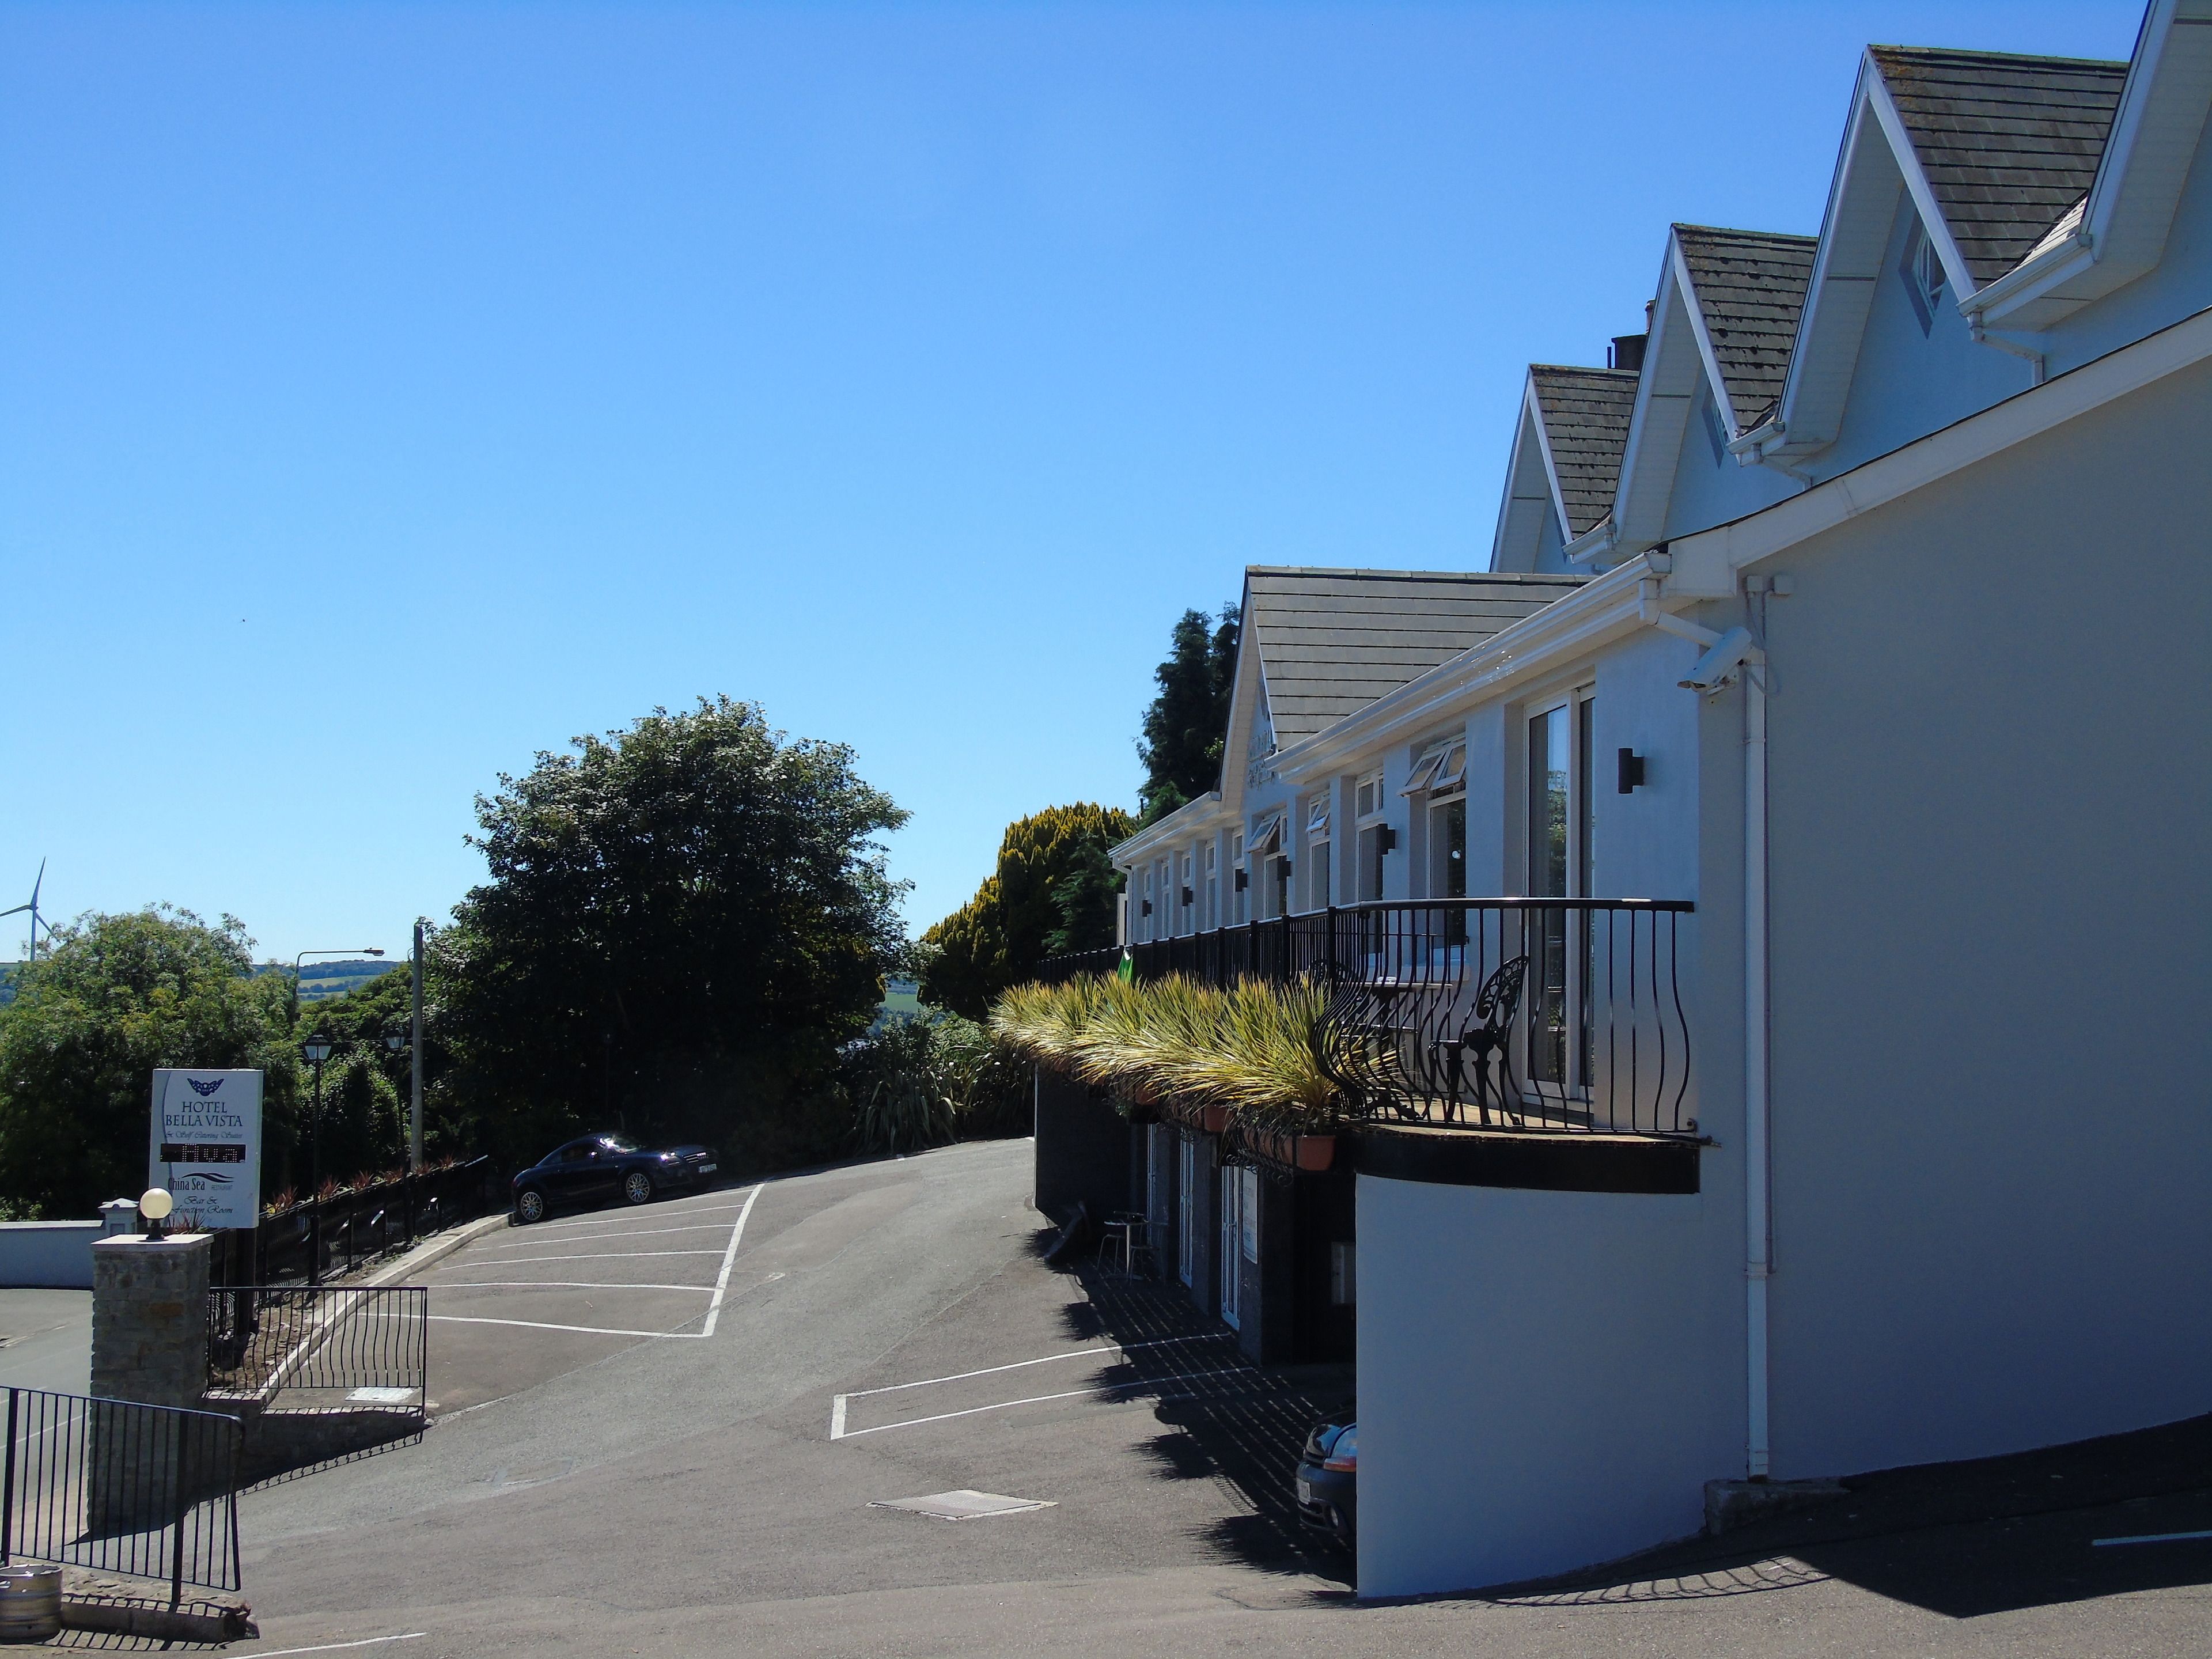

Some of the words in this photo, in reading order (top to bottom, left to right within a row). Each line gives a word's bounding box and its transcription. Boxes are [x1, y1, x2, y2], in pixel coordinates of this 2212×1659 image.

[181, 1101, 228, 1113] HOTEL
[166, 1115, 203, 1126] BELLA
[206, 1115, 243, 1127] VISTA
[168, 1177, 190, 1191] China
[192, 1177, 205, 1191] Sea
[184, 1196, 205, 1205] Bar
[207, 1205, 233, 1214] Room
